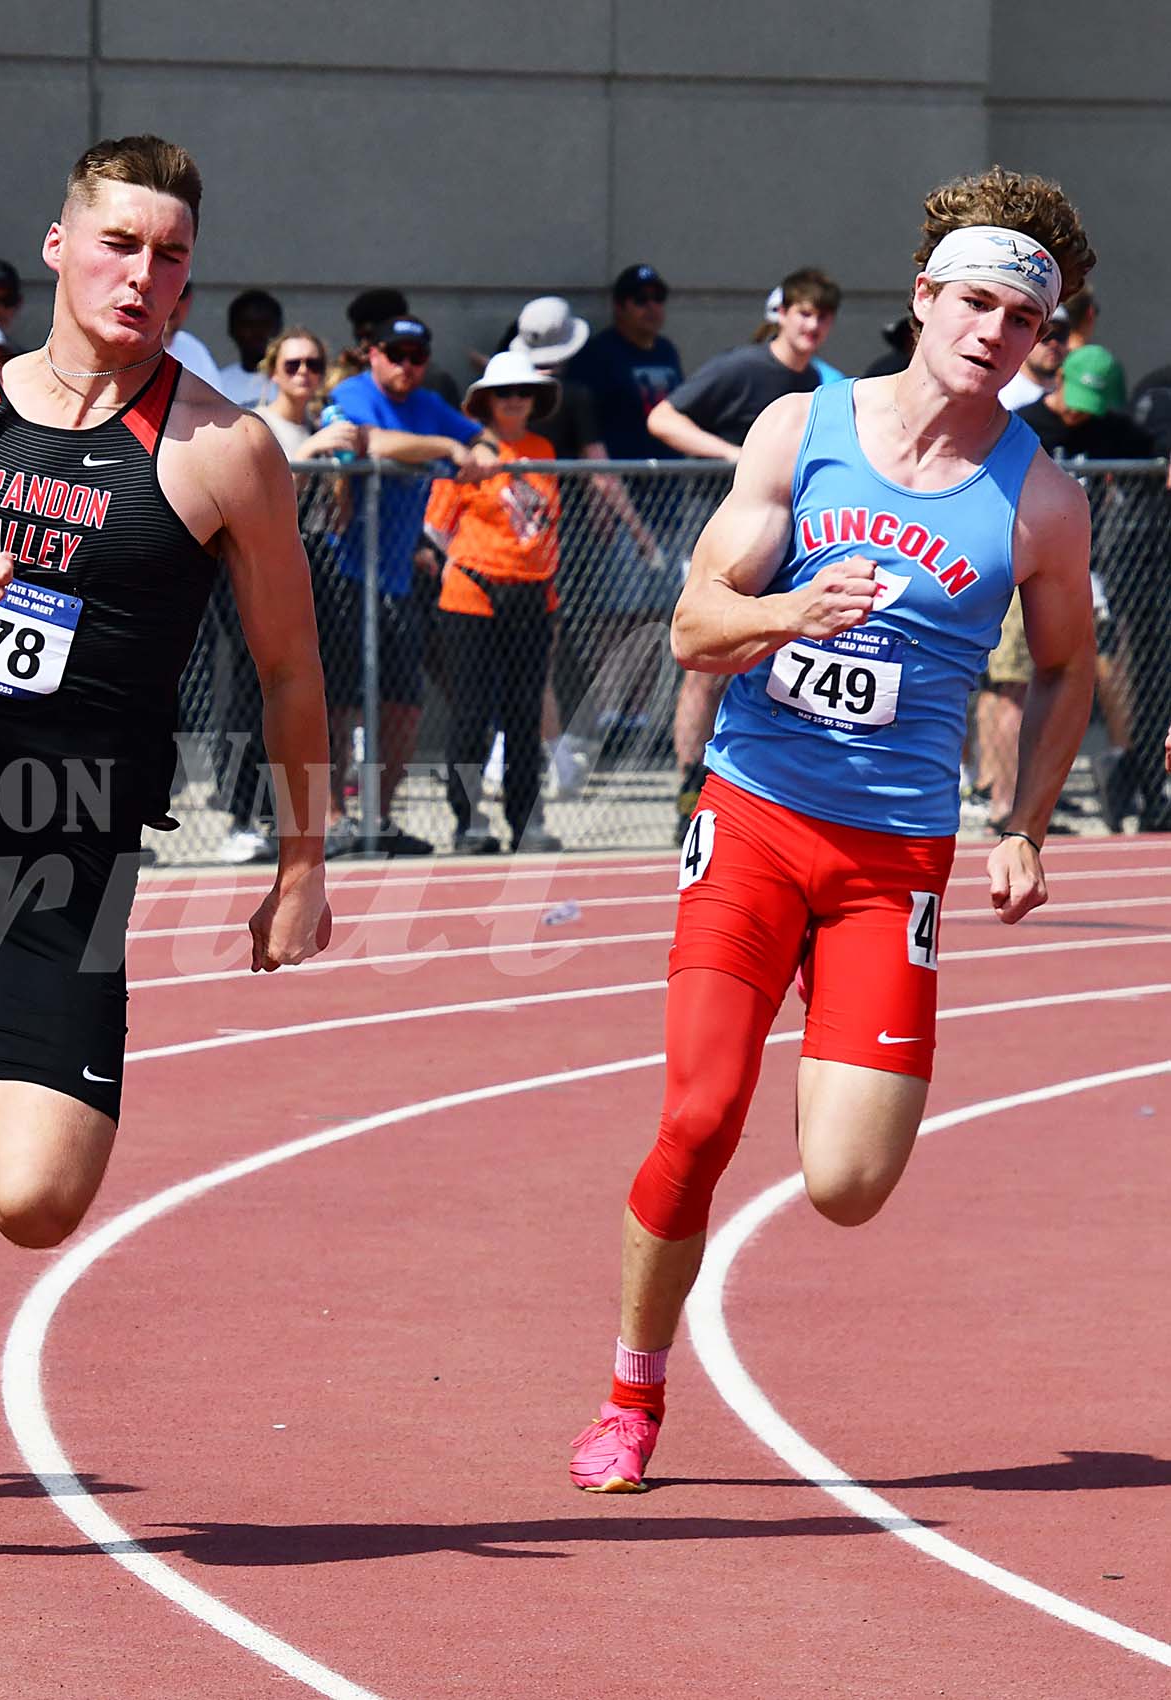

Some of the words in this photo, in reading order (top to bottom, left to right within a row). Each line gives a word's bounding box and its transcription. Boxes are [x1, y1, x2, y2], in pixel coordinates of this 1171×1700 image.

[800, 507, 980, 599] LINCOLN
[7, 594, 31, 608] FIELD
[30, 602, 55, 616] MEET
[28, 588, 57, 605] TRACK
[56, 598, 65, 608] &
[834, 640, 857, 651] FIELD
[857, 644, 880, 655] MEET
[853, 632, 880, 645] TRACK
[881, 637, 889, 646] &
[788, 651, 877, 715] 749
[797, 711, 812, 720] MAY
[835, 720, 854, 730] 2023
[685, 814, 703, 877] 4
[913, 894, 936, 964] 4
